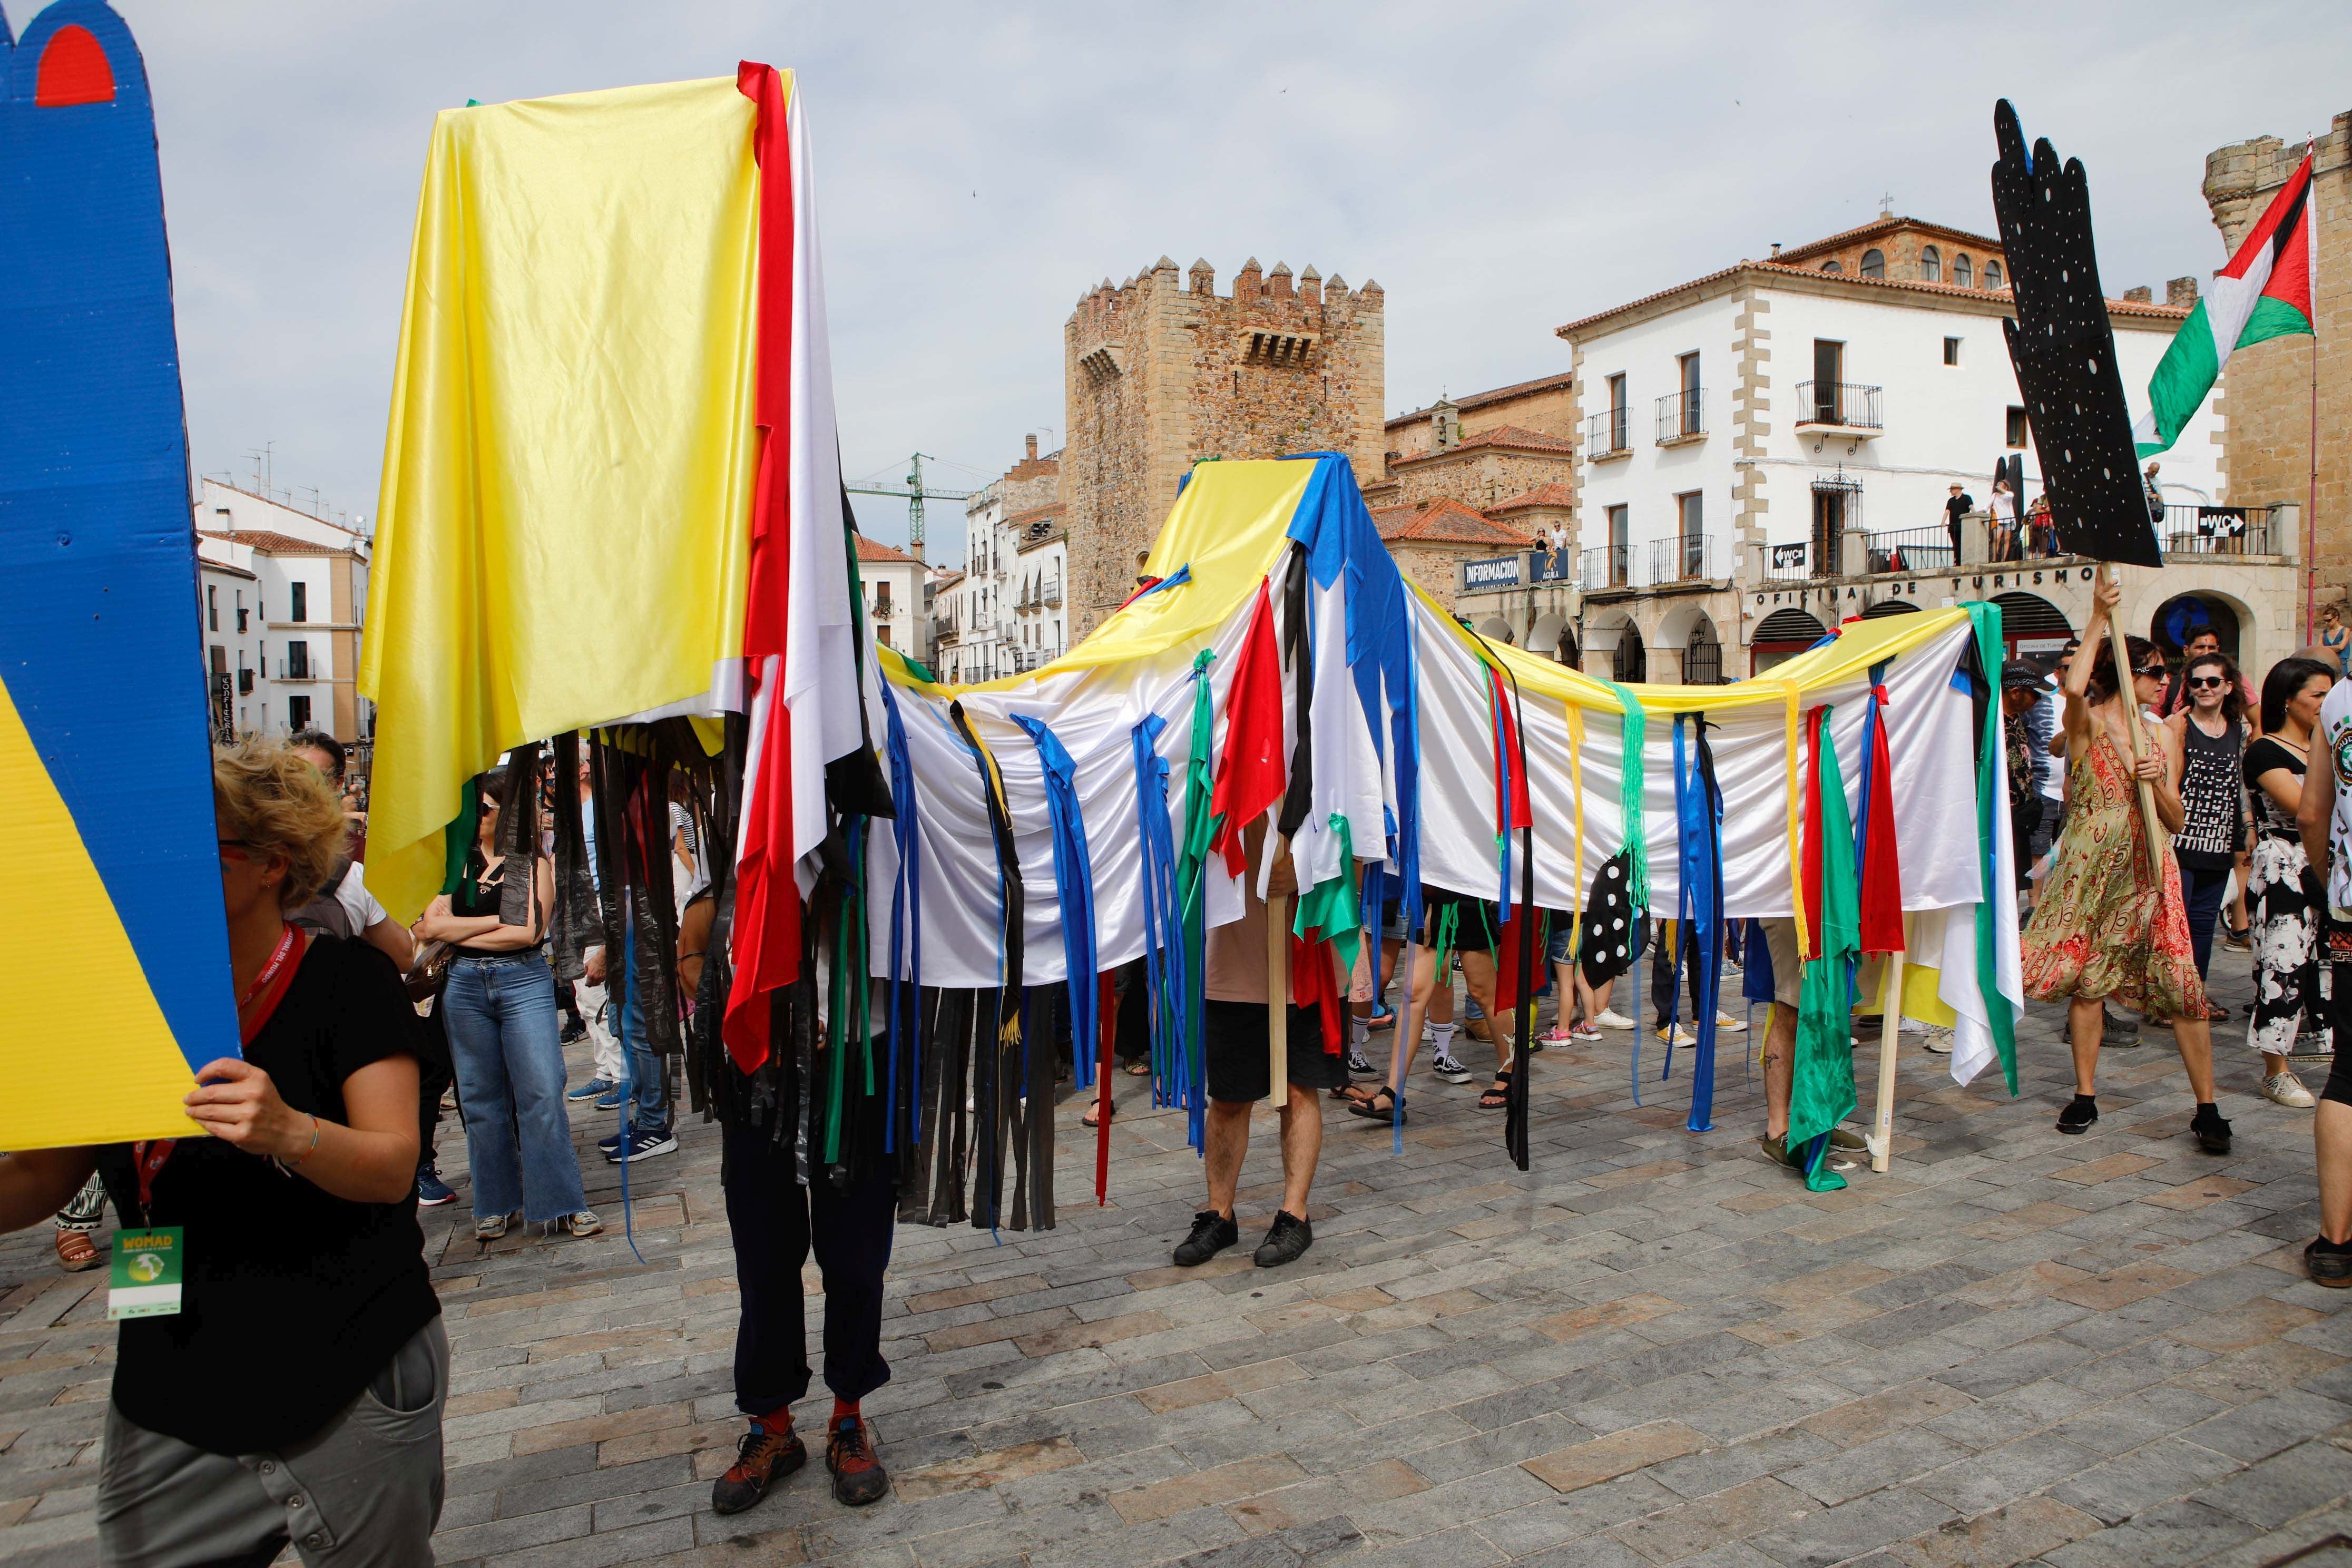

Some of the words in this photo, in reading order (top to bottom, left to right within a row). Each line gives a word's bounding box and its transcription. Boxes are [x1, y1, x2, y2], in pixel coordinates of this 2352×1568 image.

[2207, 515, 2231, 528] WC
[1783, 549, 1798, 560] WC
[1757, 587, 1856, 605] OFICINA
[1893, 582, 1915, 595] DE
[1952, 567, 2093, 591] TURISMO
[2170, 833, 2232, 853] ATTITUDE
[276, 951, 286, 962] DEL
[262, 962, 280, 983] MUNDO
[122, 1236, 173, 1249] WOMAD
